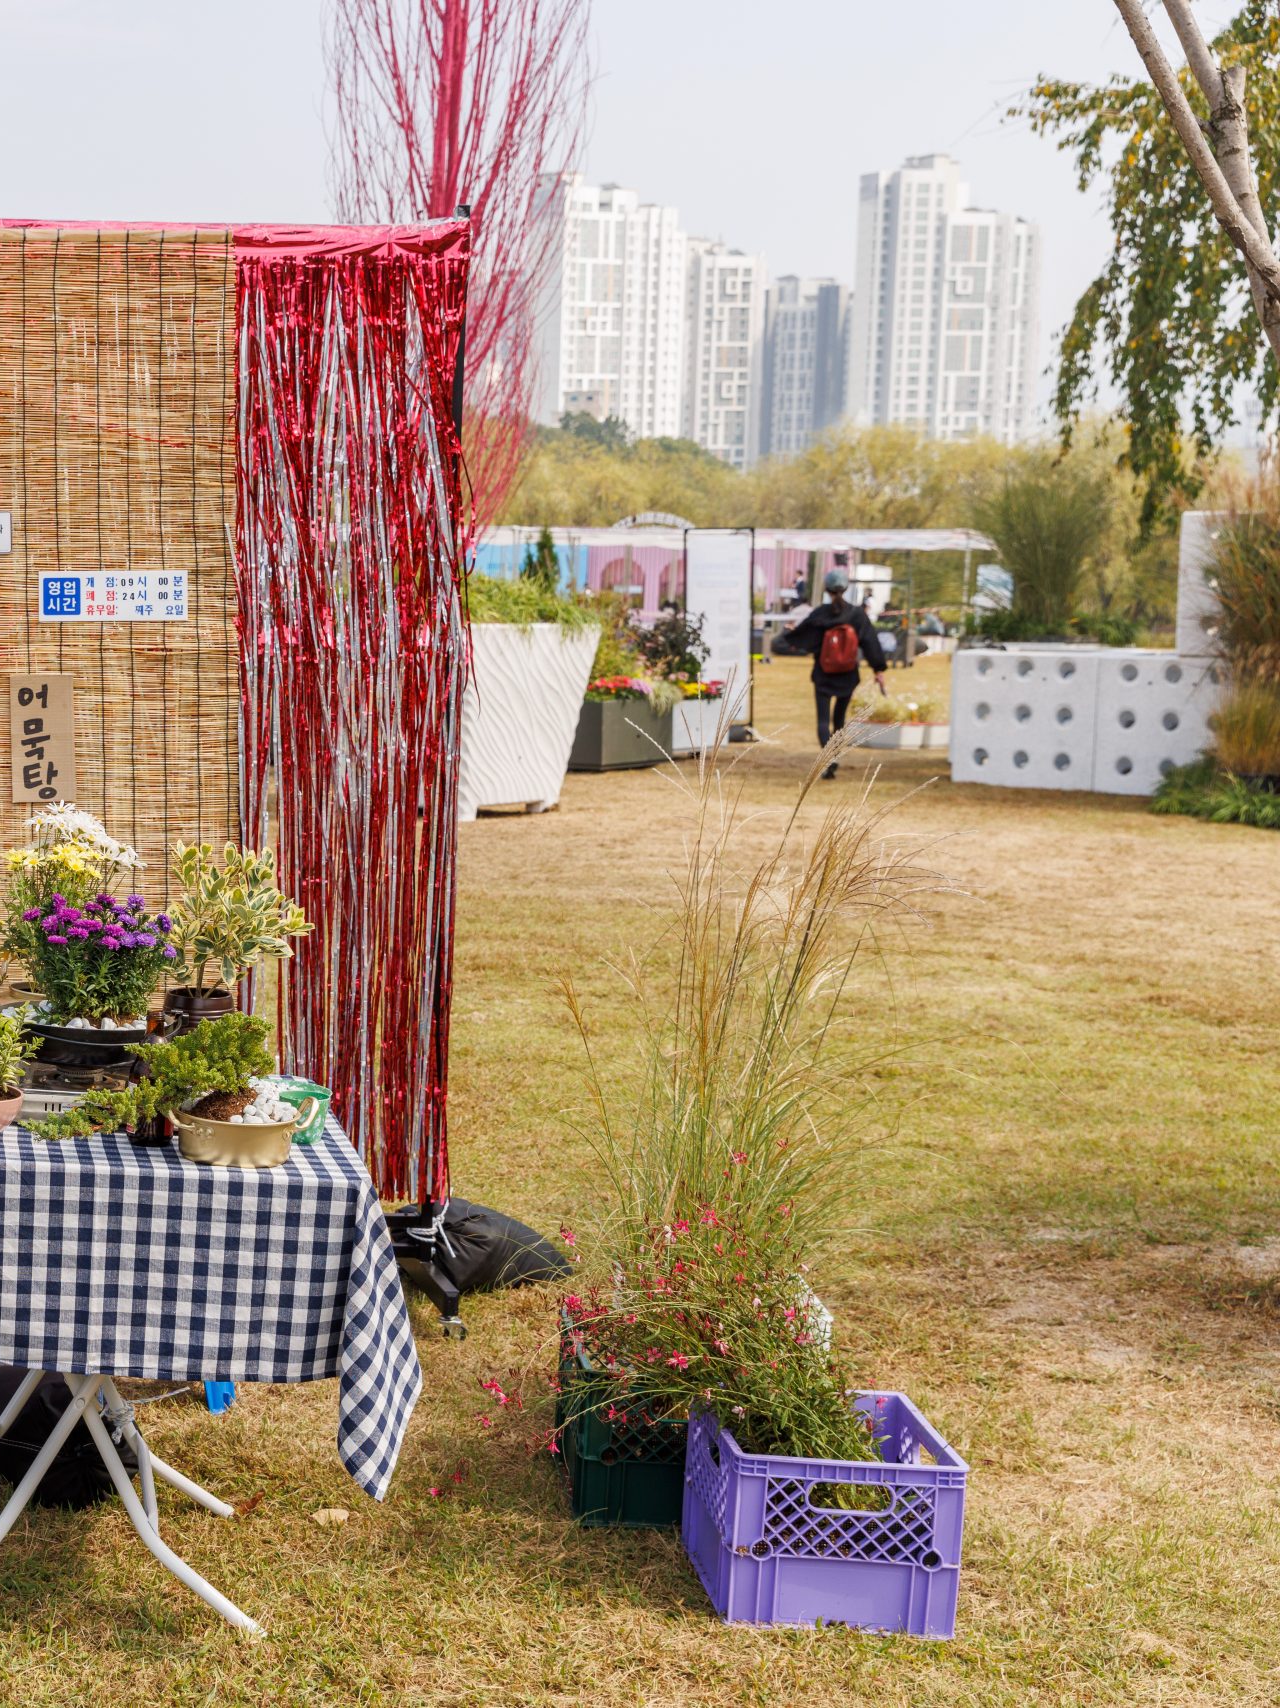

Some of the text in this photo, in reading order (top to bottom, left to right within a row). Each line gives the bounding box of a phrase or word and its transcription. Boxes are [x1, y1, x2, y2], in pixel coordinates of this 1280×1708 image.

[173, 576, 183, 586] 분
[49, 582, 75, 595] 영업
[173, 590, 183, 600] 분
[48, 598, 76, 611] 시간
[166, 605, 183, 615] 요일
[18, 684, 58, 799] 어묵탕
